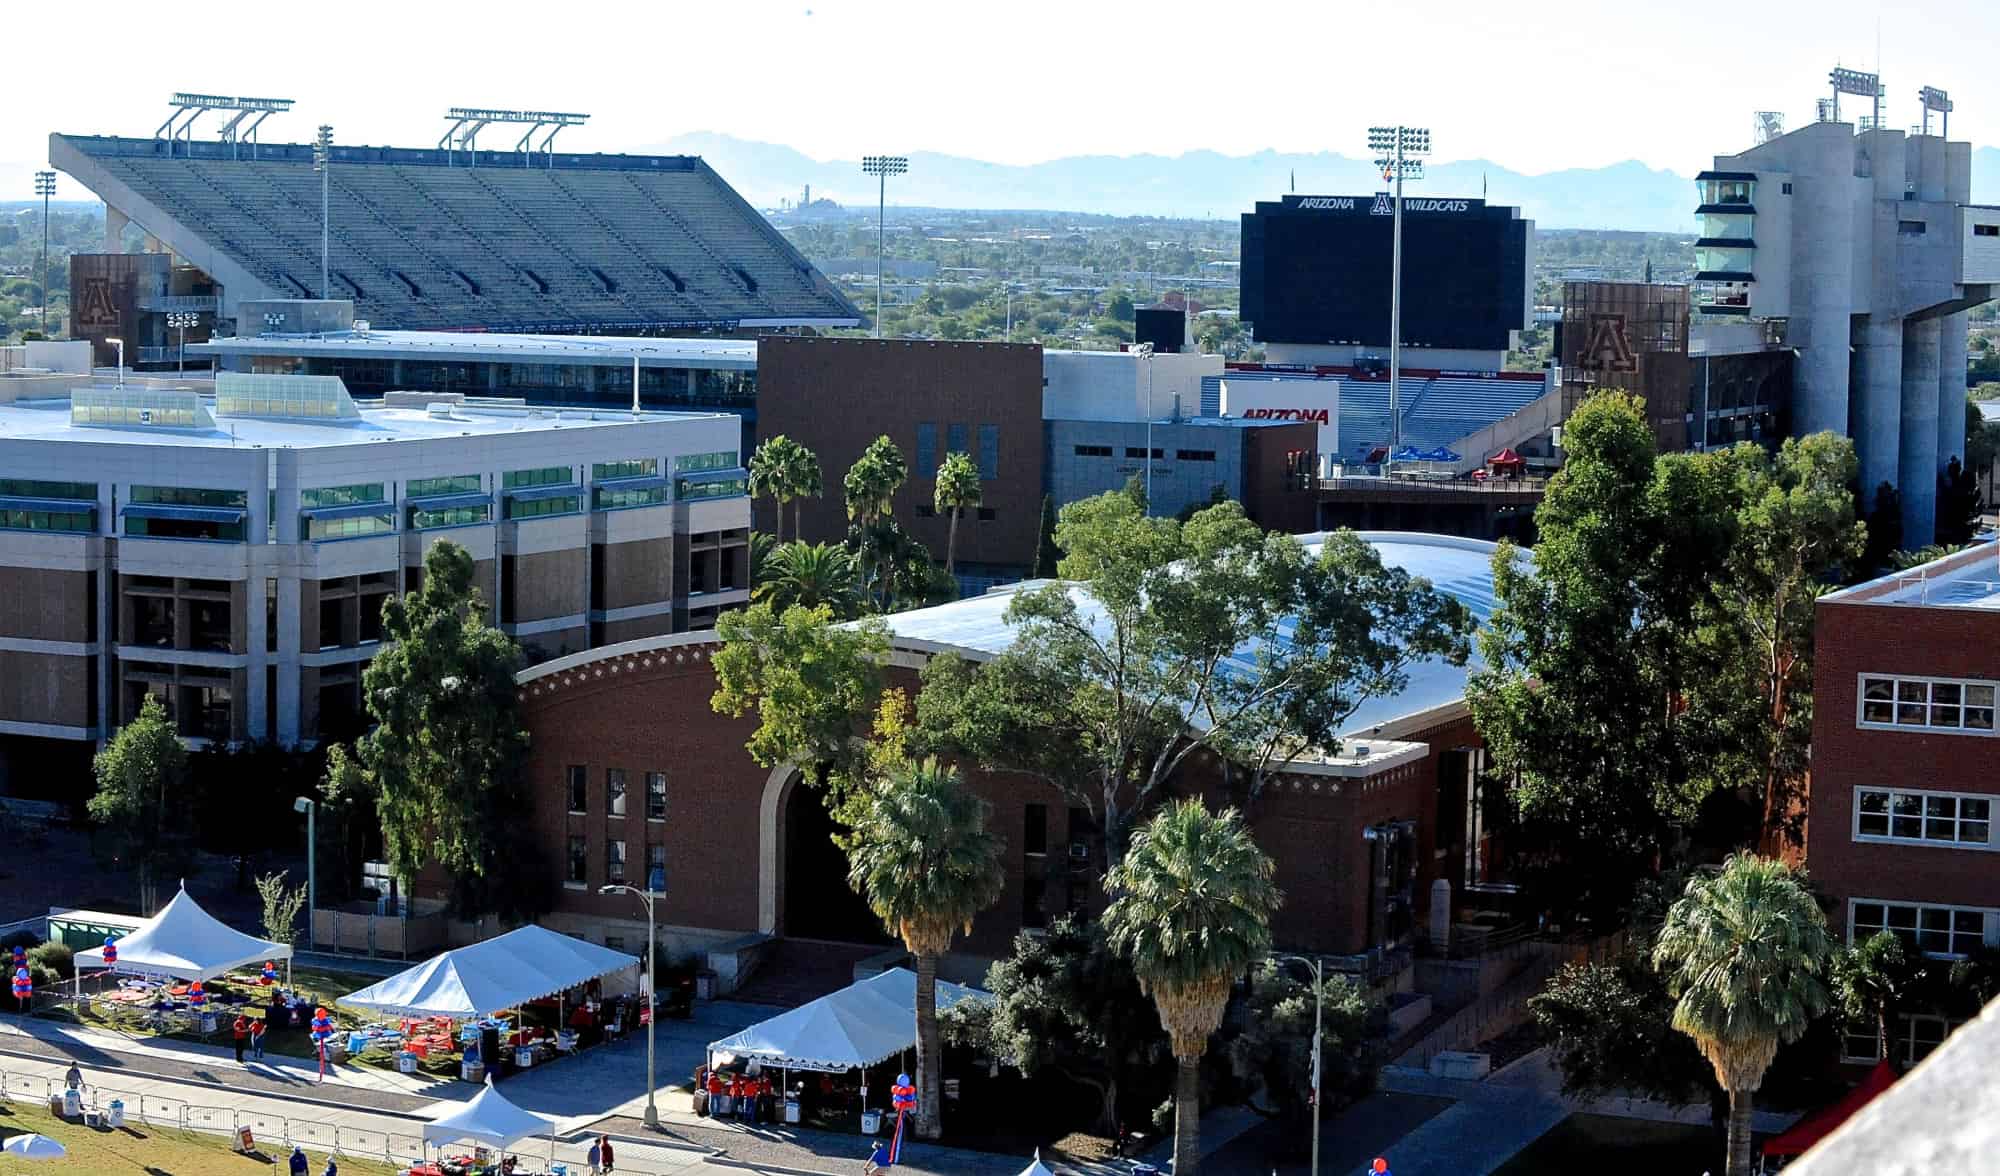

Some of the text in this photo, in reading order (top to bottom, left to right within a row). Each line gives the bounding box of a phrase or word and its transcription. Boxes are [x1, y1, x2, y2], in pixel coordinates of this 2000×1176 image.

[1298, 193, 1469, 215] ARIZONA A WILDCATS
[79, 277, 121, 328] A
[1577, 312, 1640, 374] A
